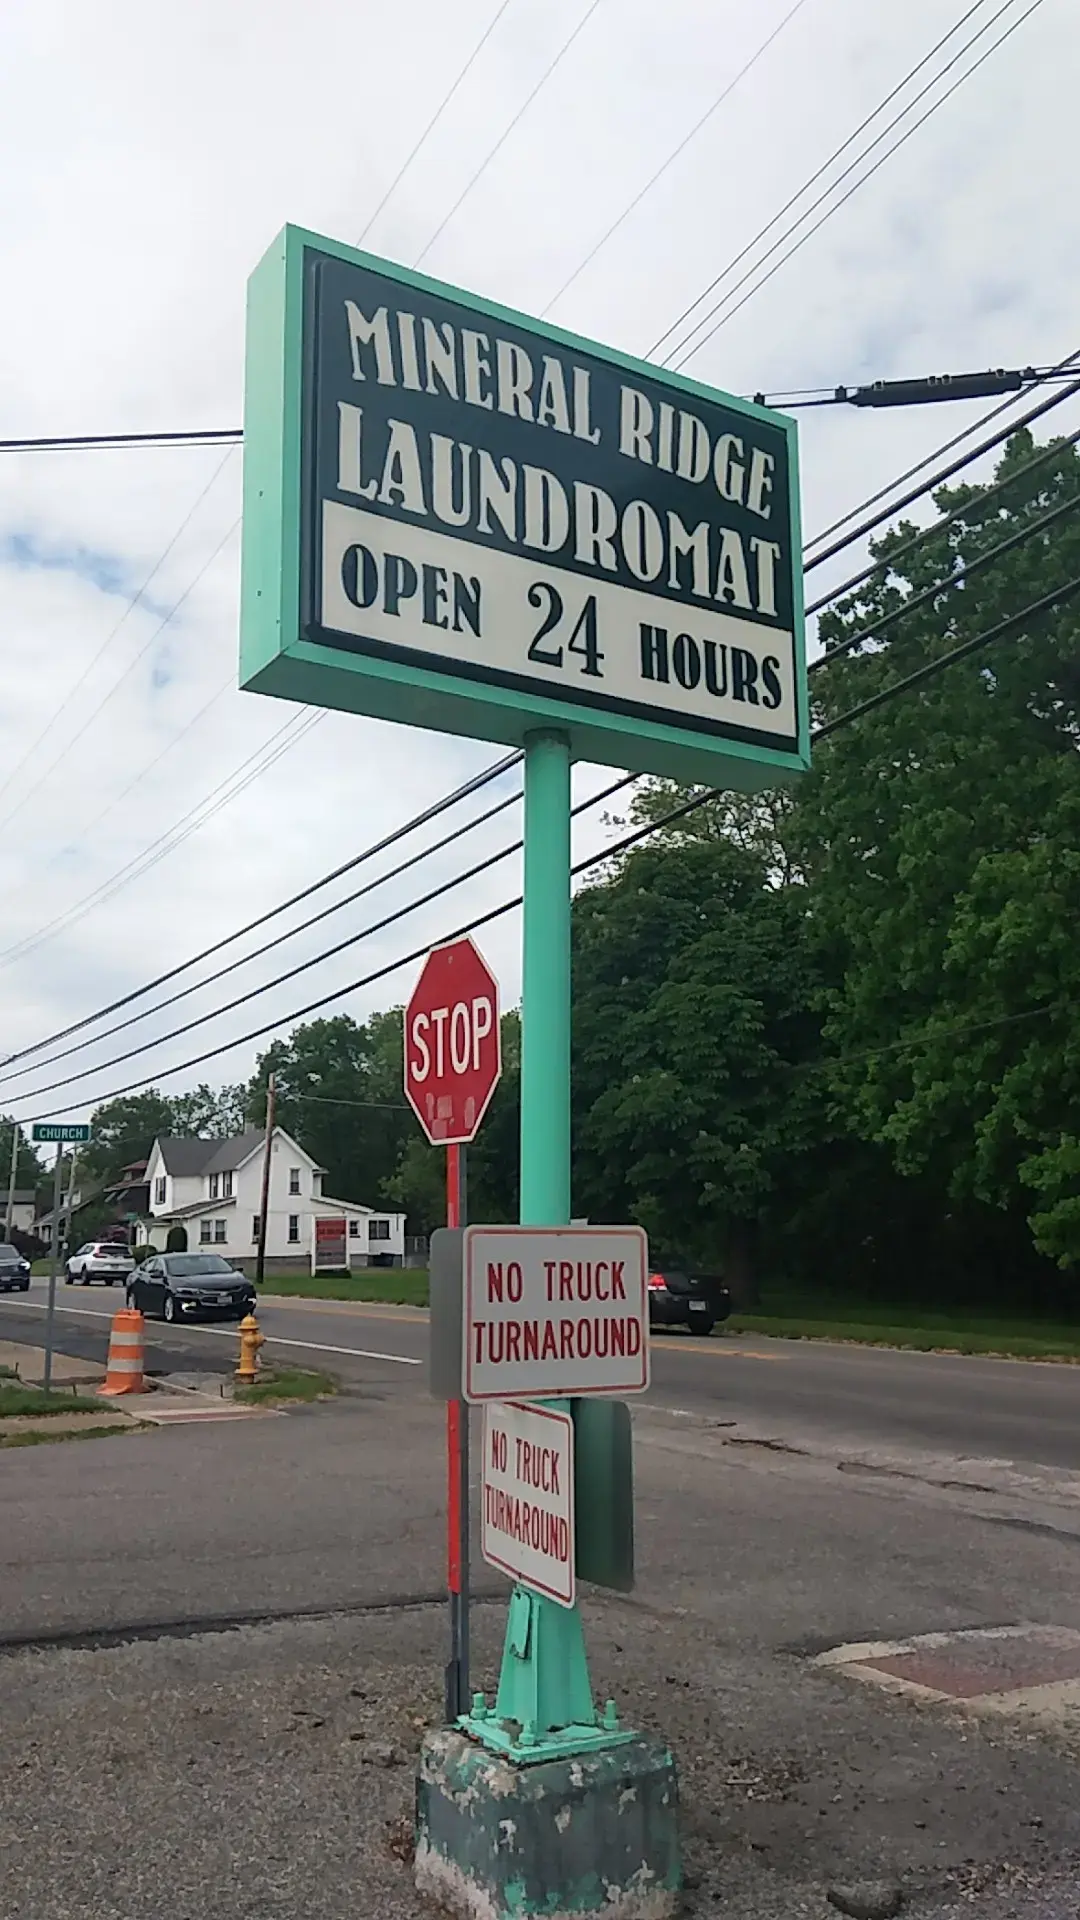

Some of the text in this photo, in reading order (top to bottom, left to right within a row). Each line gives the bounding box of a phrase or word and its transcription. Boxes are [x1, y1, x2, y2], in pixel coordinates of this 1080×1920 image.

[344, 299, 776, 520] MINERAL RIDGE
[336, 400, 781, 618] LAUNDROMAT
[341, 543, 783, 710] OPEN 24 HOURS
[411, 996, 492, 1083] STOP
[39, 1127, 83, 1139] CHURCH
[487, 1261, 627, 1303] NO TRUCK
[472, 1316, 641, 1364] TURNAROUND
[491, 1428, 560, 1496] NO TRUCK
[484, 1482, 569, 1563] TURNAROUND
